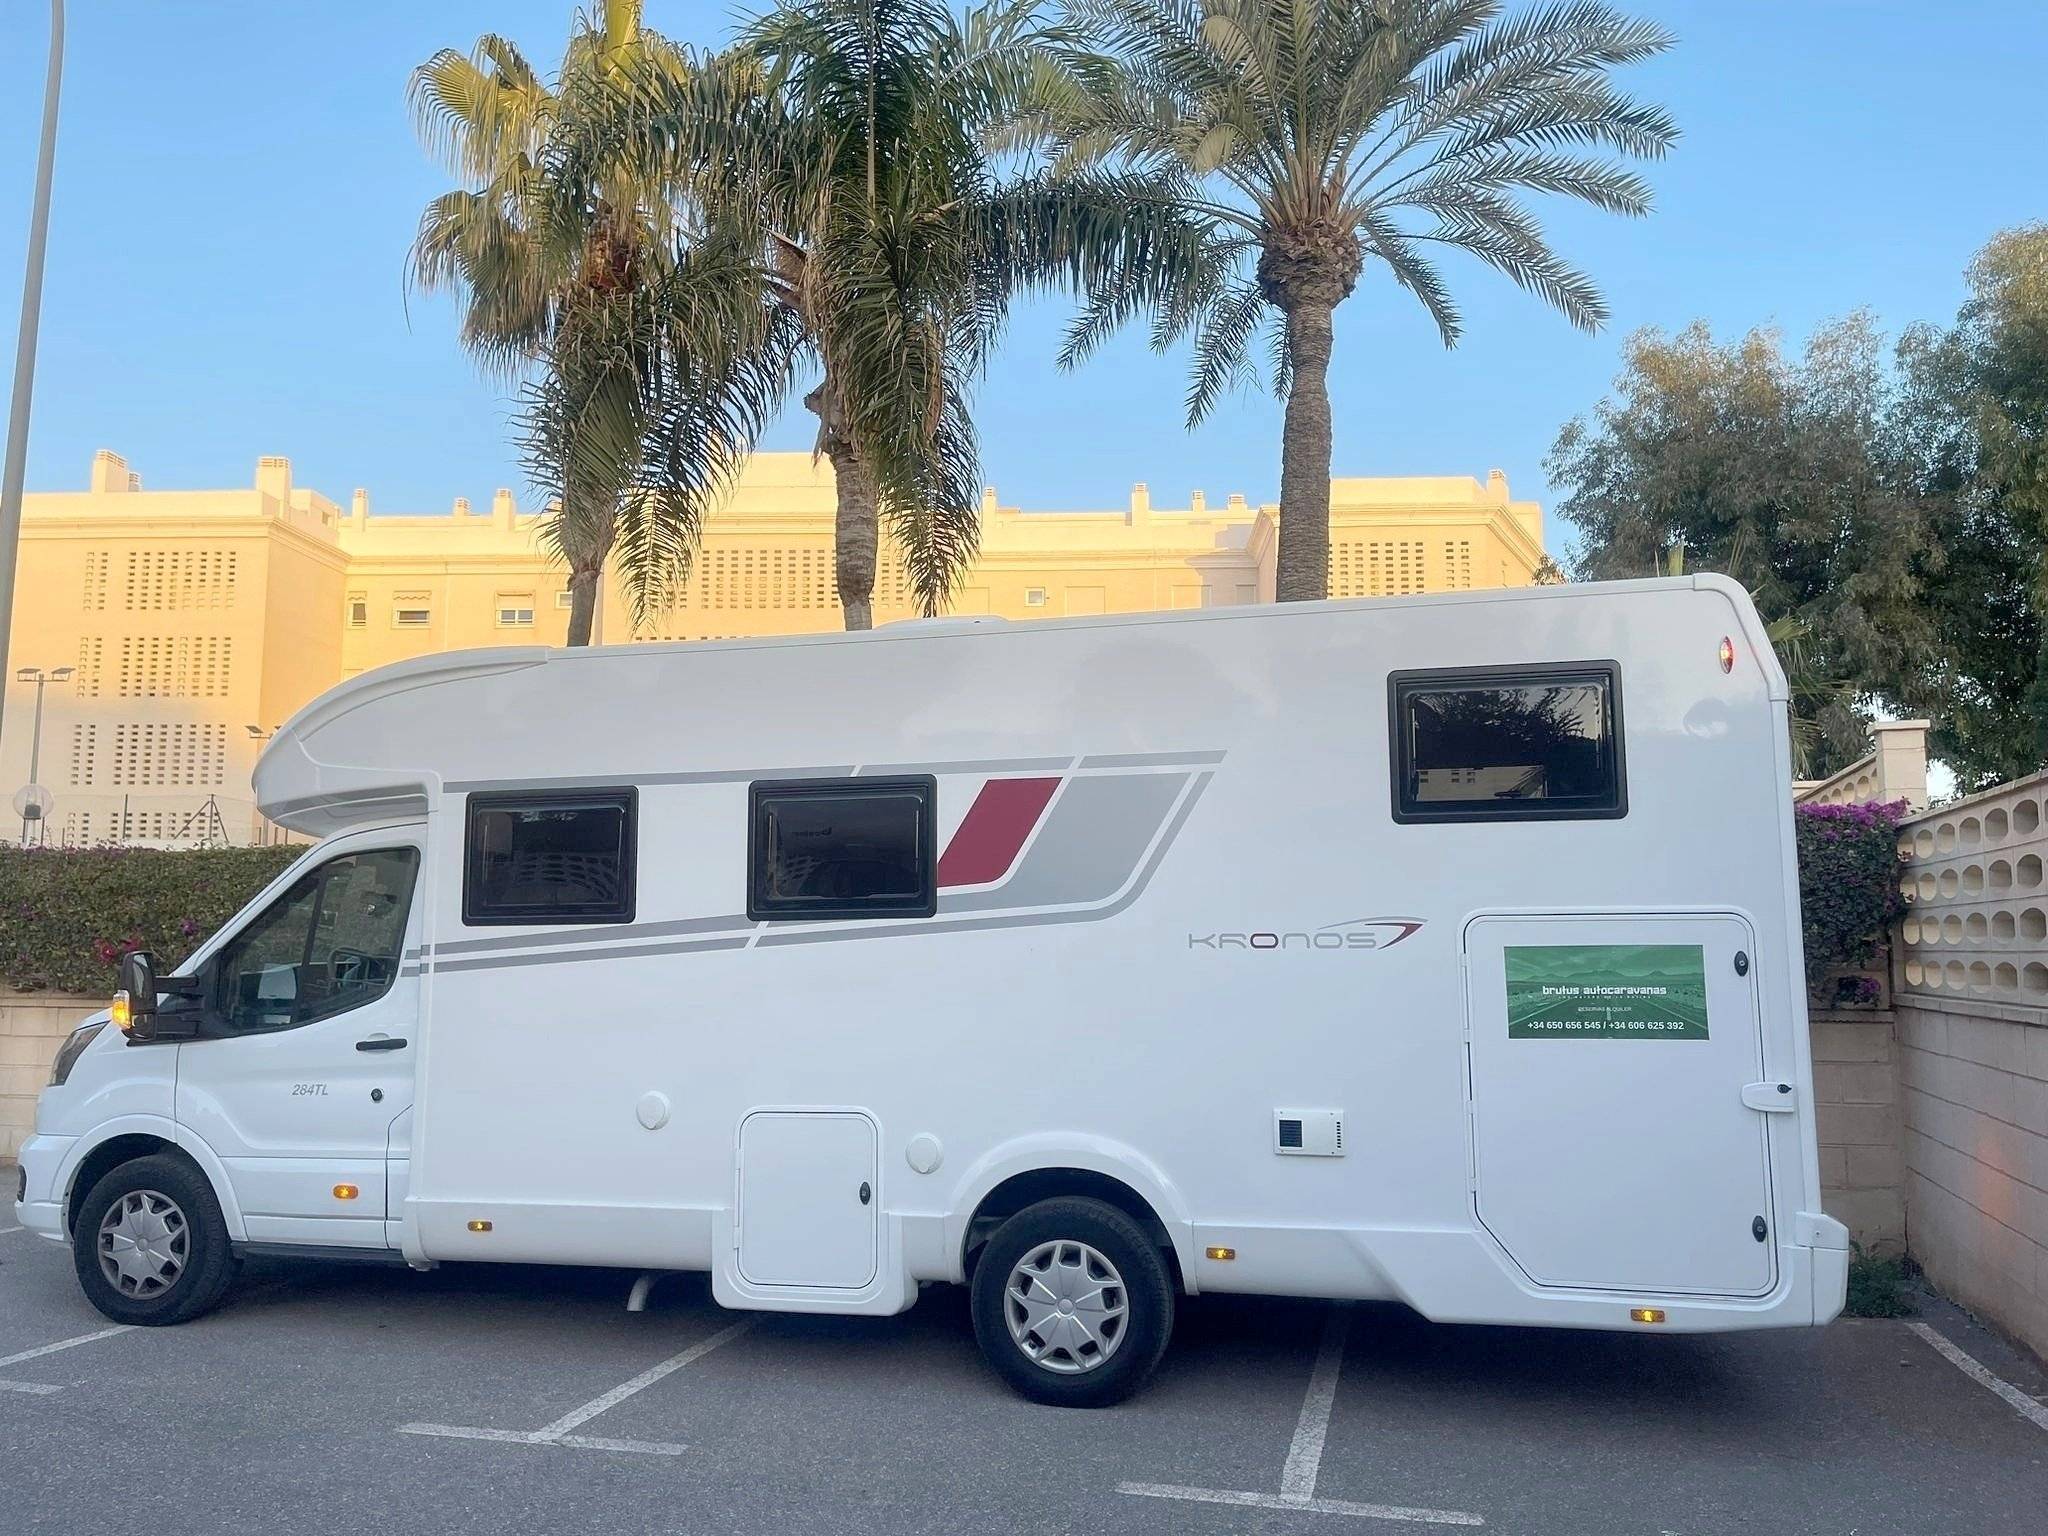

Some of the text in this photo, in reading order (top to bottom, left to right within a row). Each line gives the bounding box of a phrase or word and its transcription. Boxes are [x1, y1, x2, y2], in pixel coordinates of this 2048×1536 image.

[1188, 932, 1377, 949] KRONOS
[1542, 985, 1667, 995] brutus autocaravanas
[1527, 1021, 1544, 1030] +34
[1547, 1021, 1563, 1030] 650
[1565, 1021, 1582, 1030] 656
[1584, 1021, 1601, 1030] 545
[1609, 1021, 1626, 1030] +34
[1628, 1021, 1645, 1030] 606
[1647, 1021, 1664, 1030] 625
[1667, 1021, 1685, 1030] 392
[291, 1083, 329, 1096] 284TL
